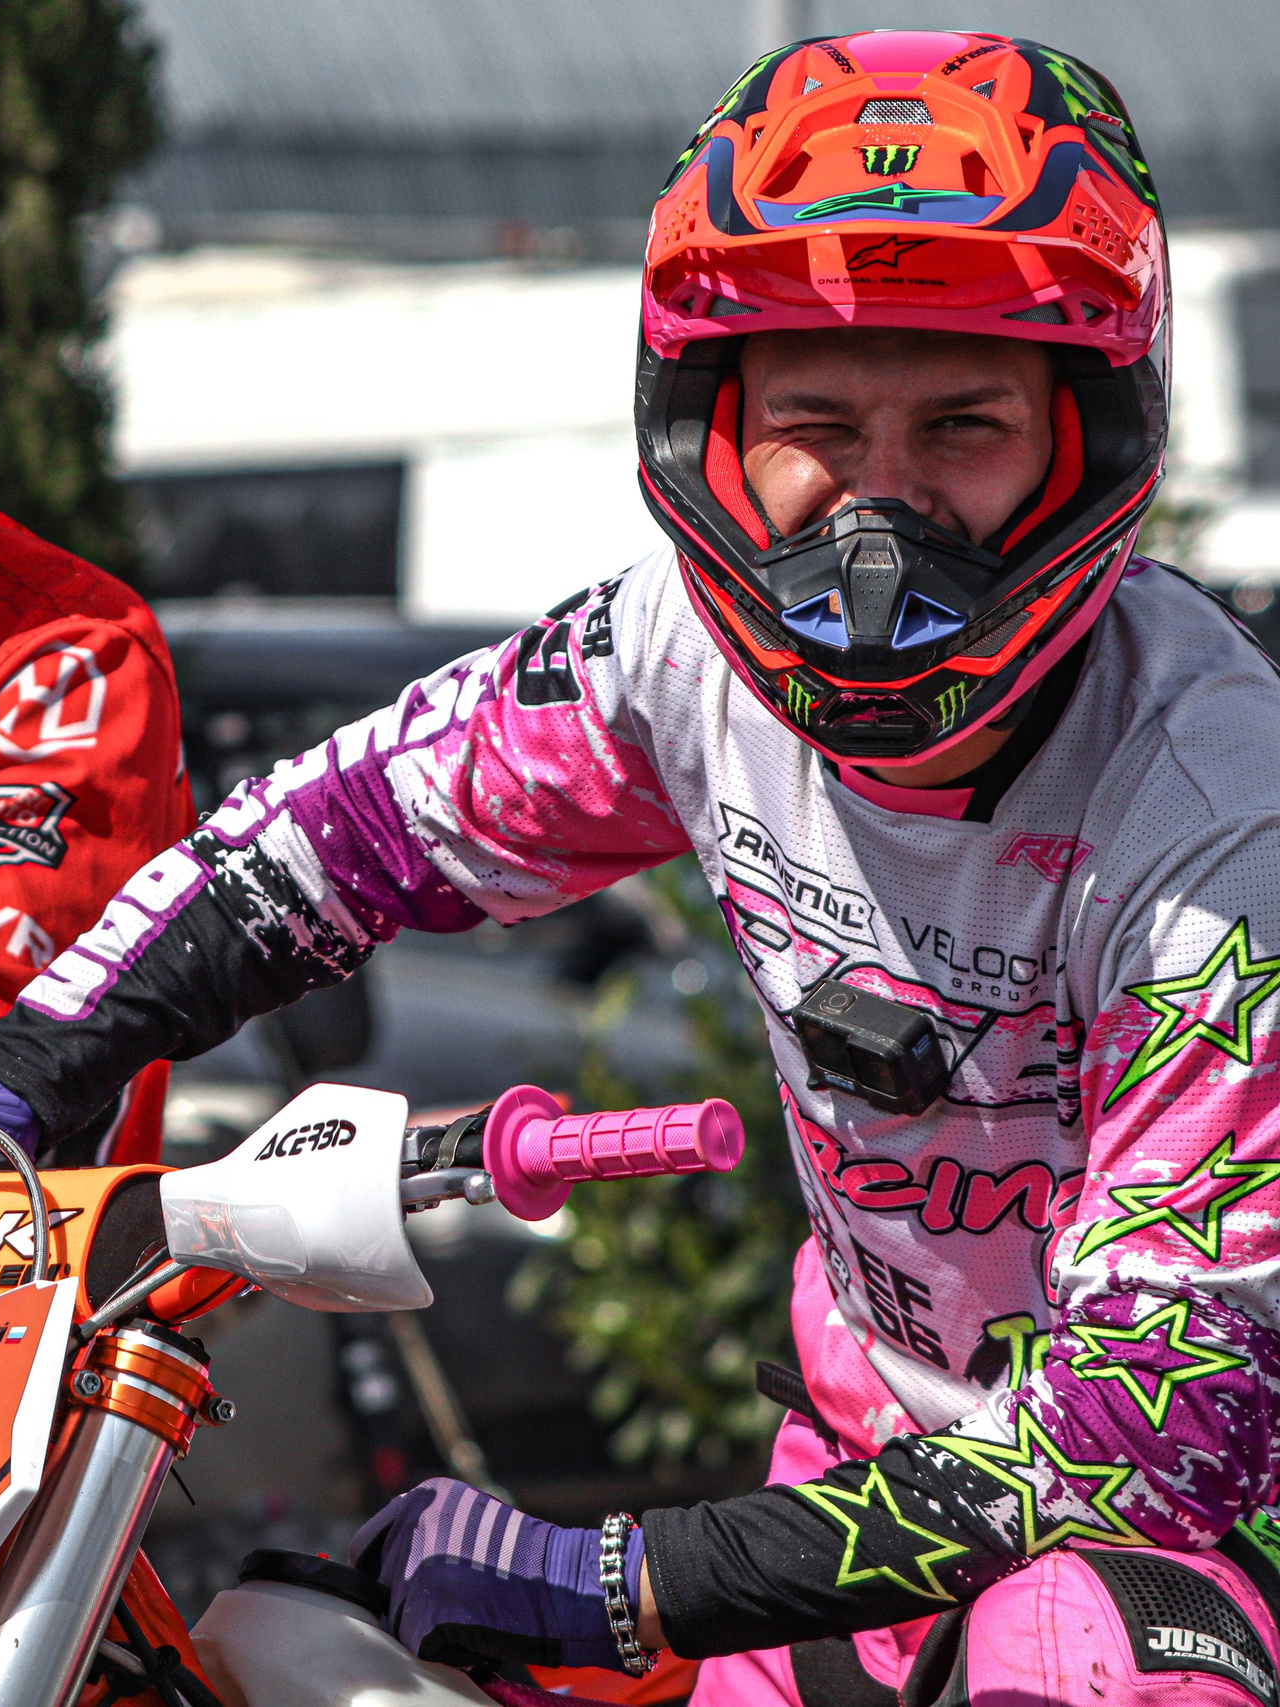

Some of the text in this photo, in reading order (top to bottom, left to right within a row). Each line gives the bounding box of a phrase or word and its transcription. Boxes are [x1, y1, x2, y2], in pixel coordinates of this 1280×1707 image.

[818, 277, 840, 285] ONE
[900, 916, 1058, 986] VELOCI
[951, 976, 1039, 1001] GROUP
